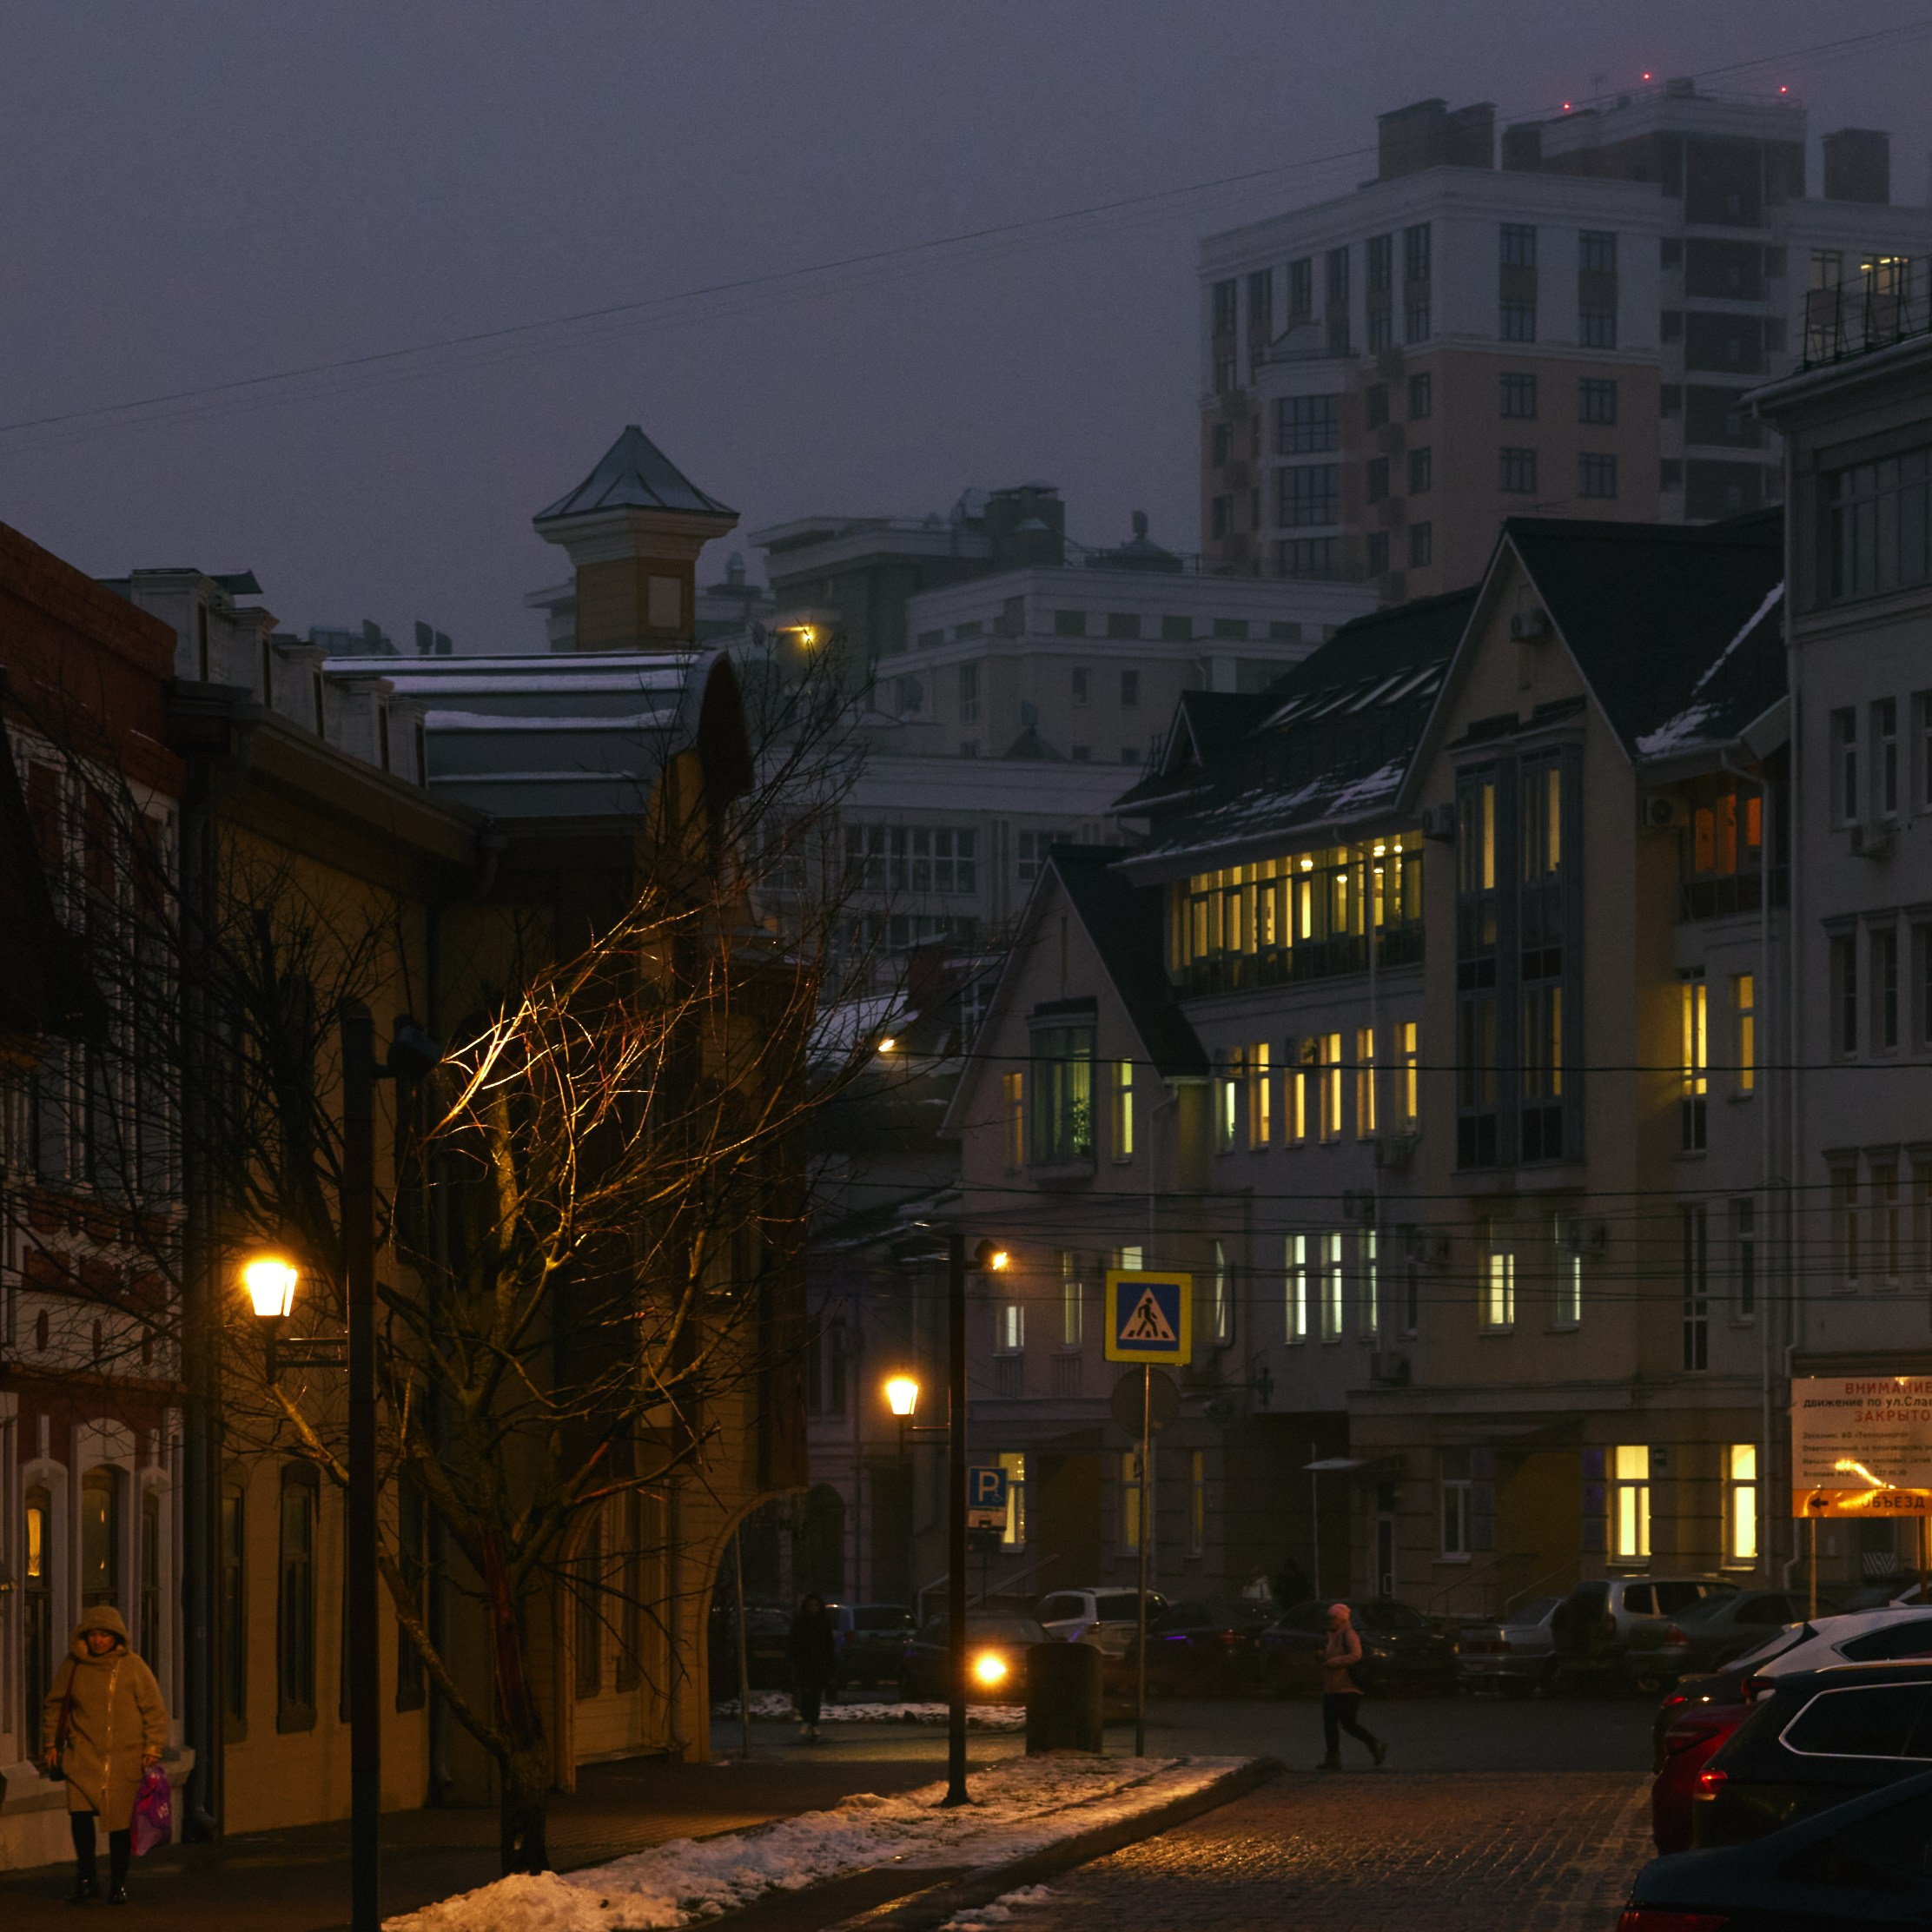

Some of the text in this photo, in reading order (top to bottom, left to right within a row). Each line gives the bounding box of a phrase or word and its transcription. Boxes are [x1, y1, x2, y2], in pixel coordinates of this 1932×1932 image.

[1803, 1399, 1863, 1408] движение
[1855, 1410, 1931, 1422] ЗАКРЫТО
[978, 1471, 999, 1502] P
